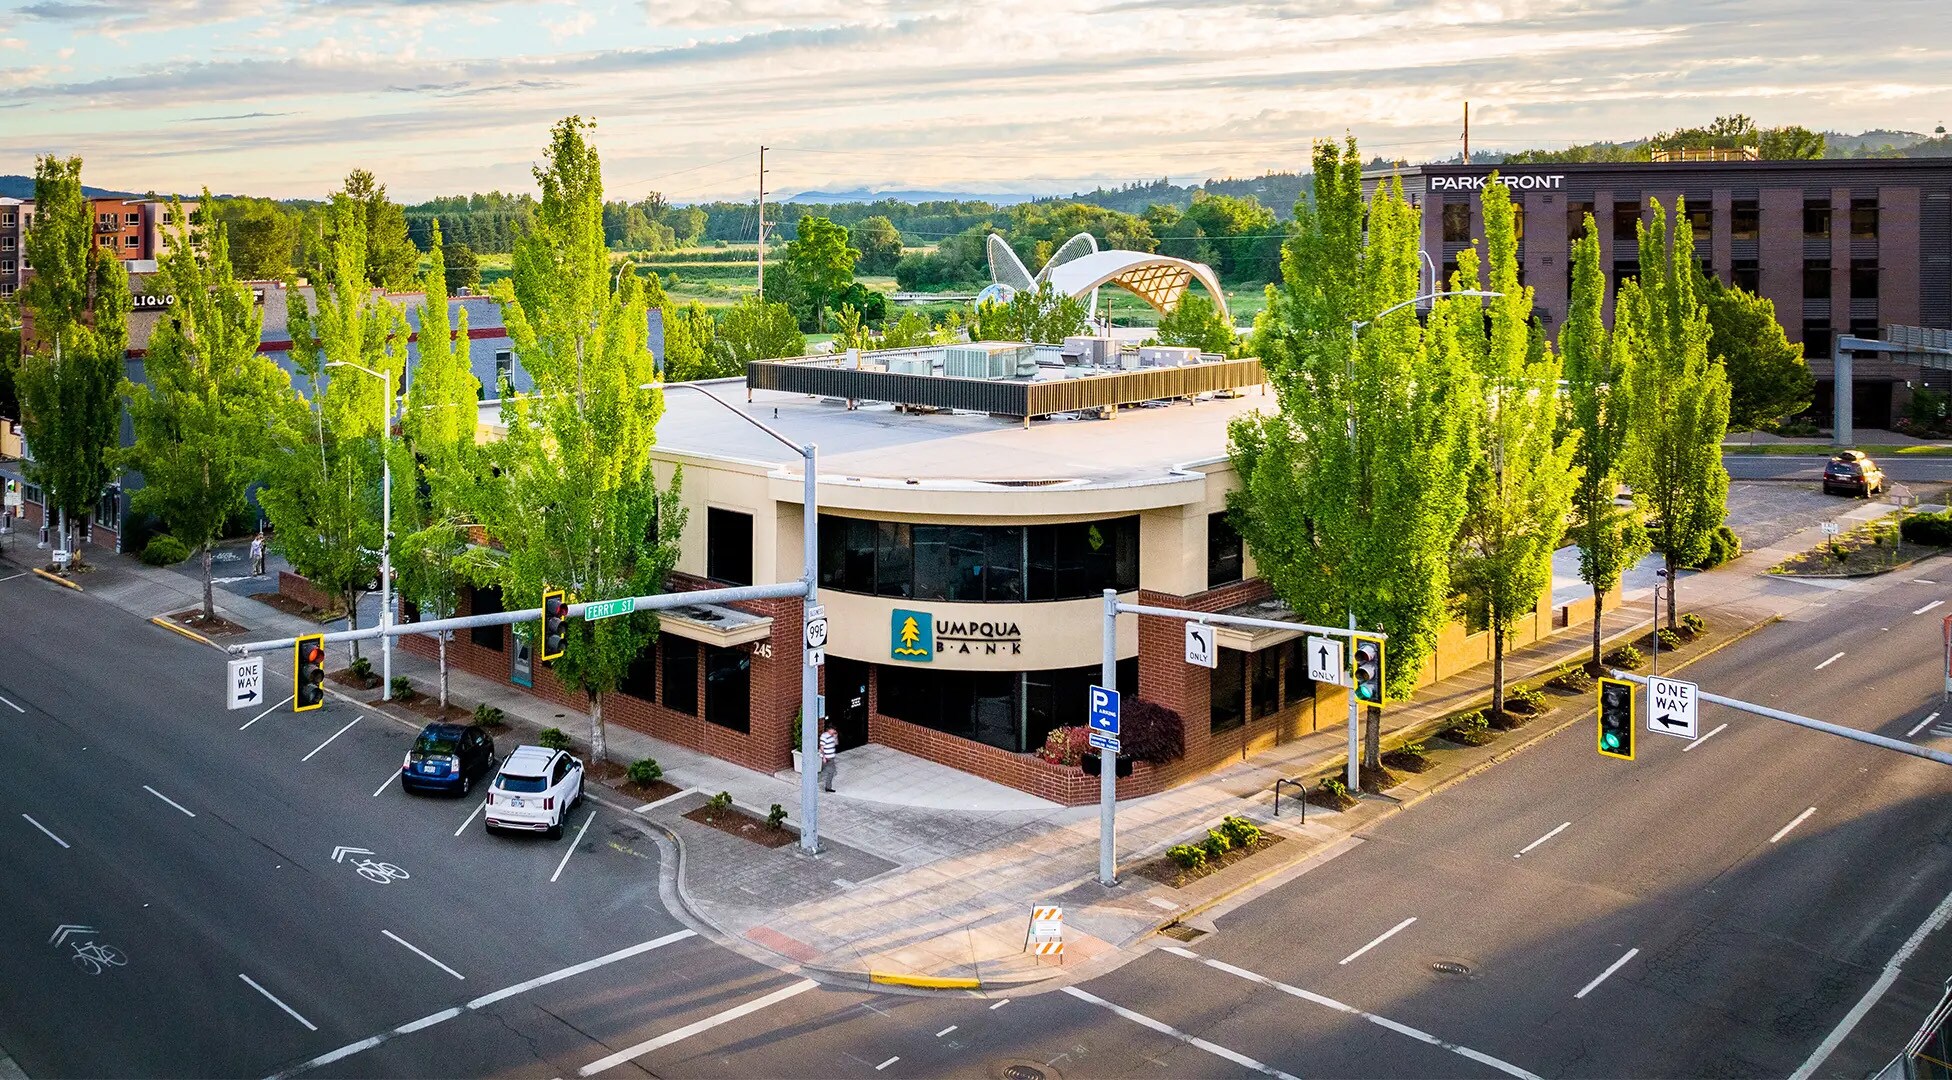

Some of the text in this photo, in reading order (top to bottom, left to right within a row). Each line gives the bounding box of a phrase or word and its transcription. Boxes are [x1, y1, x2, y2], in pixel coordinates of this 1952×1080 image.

[1431, 176, 1487, 190] PARK
[133, 295, 174, 306] LIQUO
[588, 600, 632, 619] FERRY ST
[809, 623, 824, 639] 99E
[936, 620, 1021, 637] UMPQUA
[753, 642, 772, 659] 245
[1189, 653, 1209, 663] ONLY
[238, 664, 258, 677] ONE
[1312, 670, 1336, 682] ONLY
[237, 676, 259, 689] WAY
[1656, 682, 1688, 699] ONE
[1655, 696, 1689, 713] WAY
